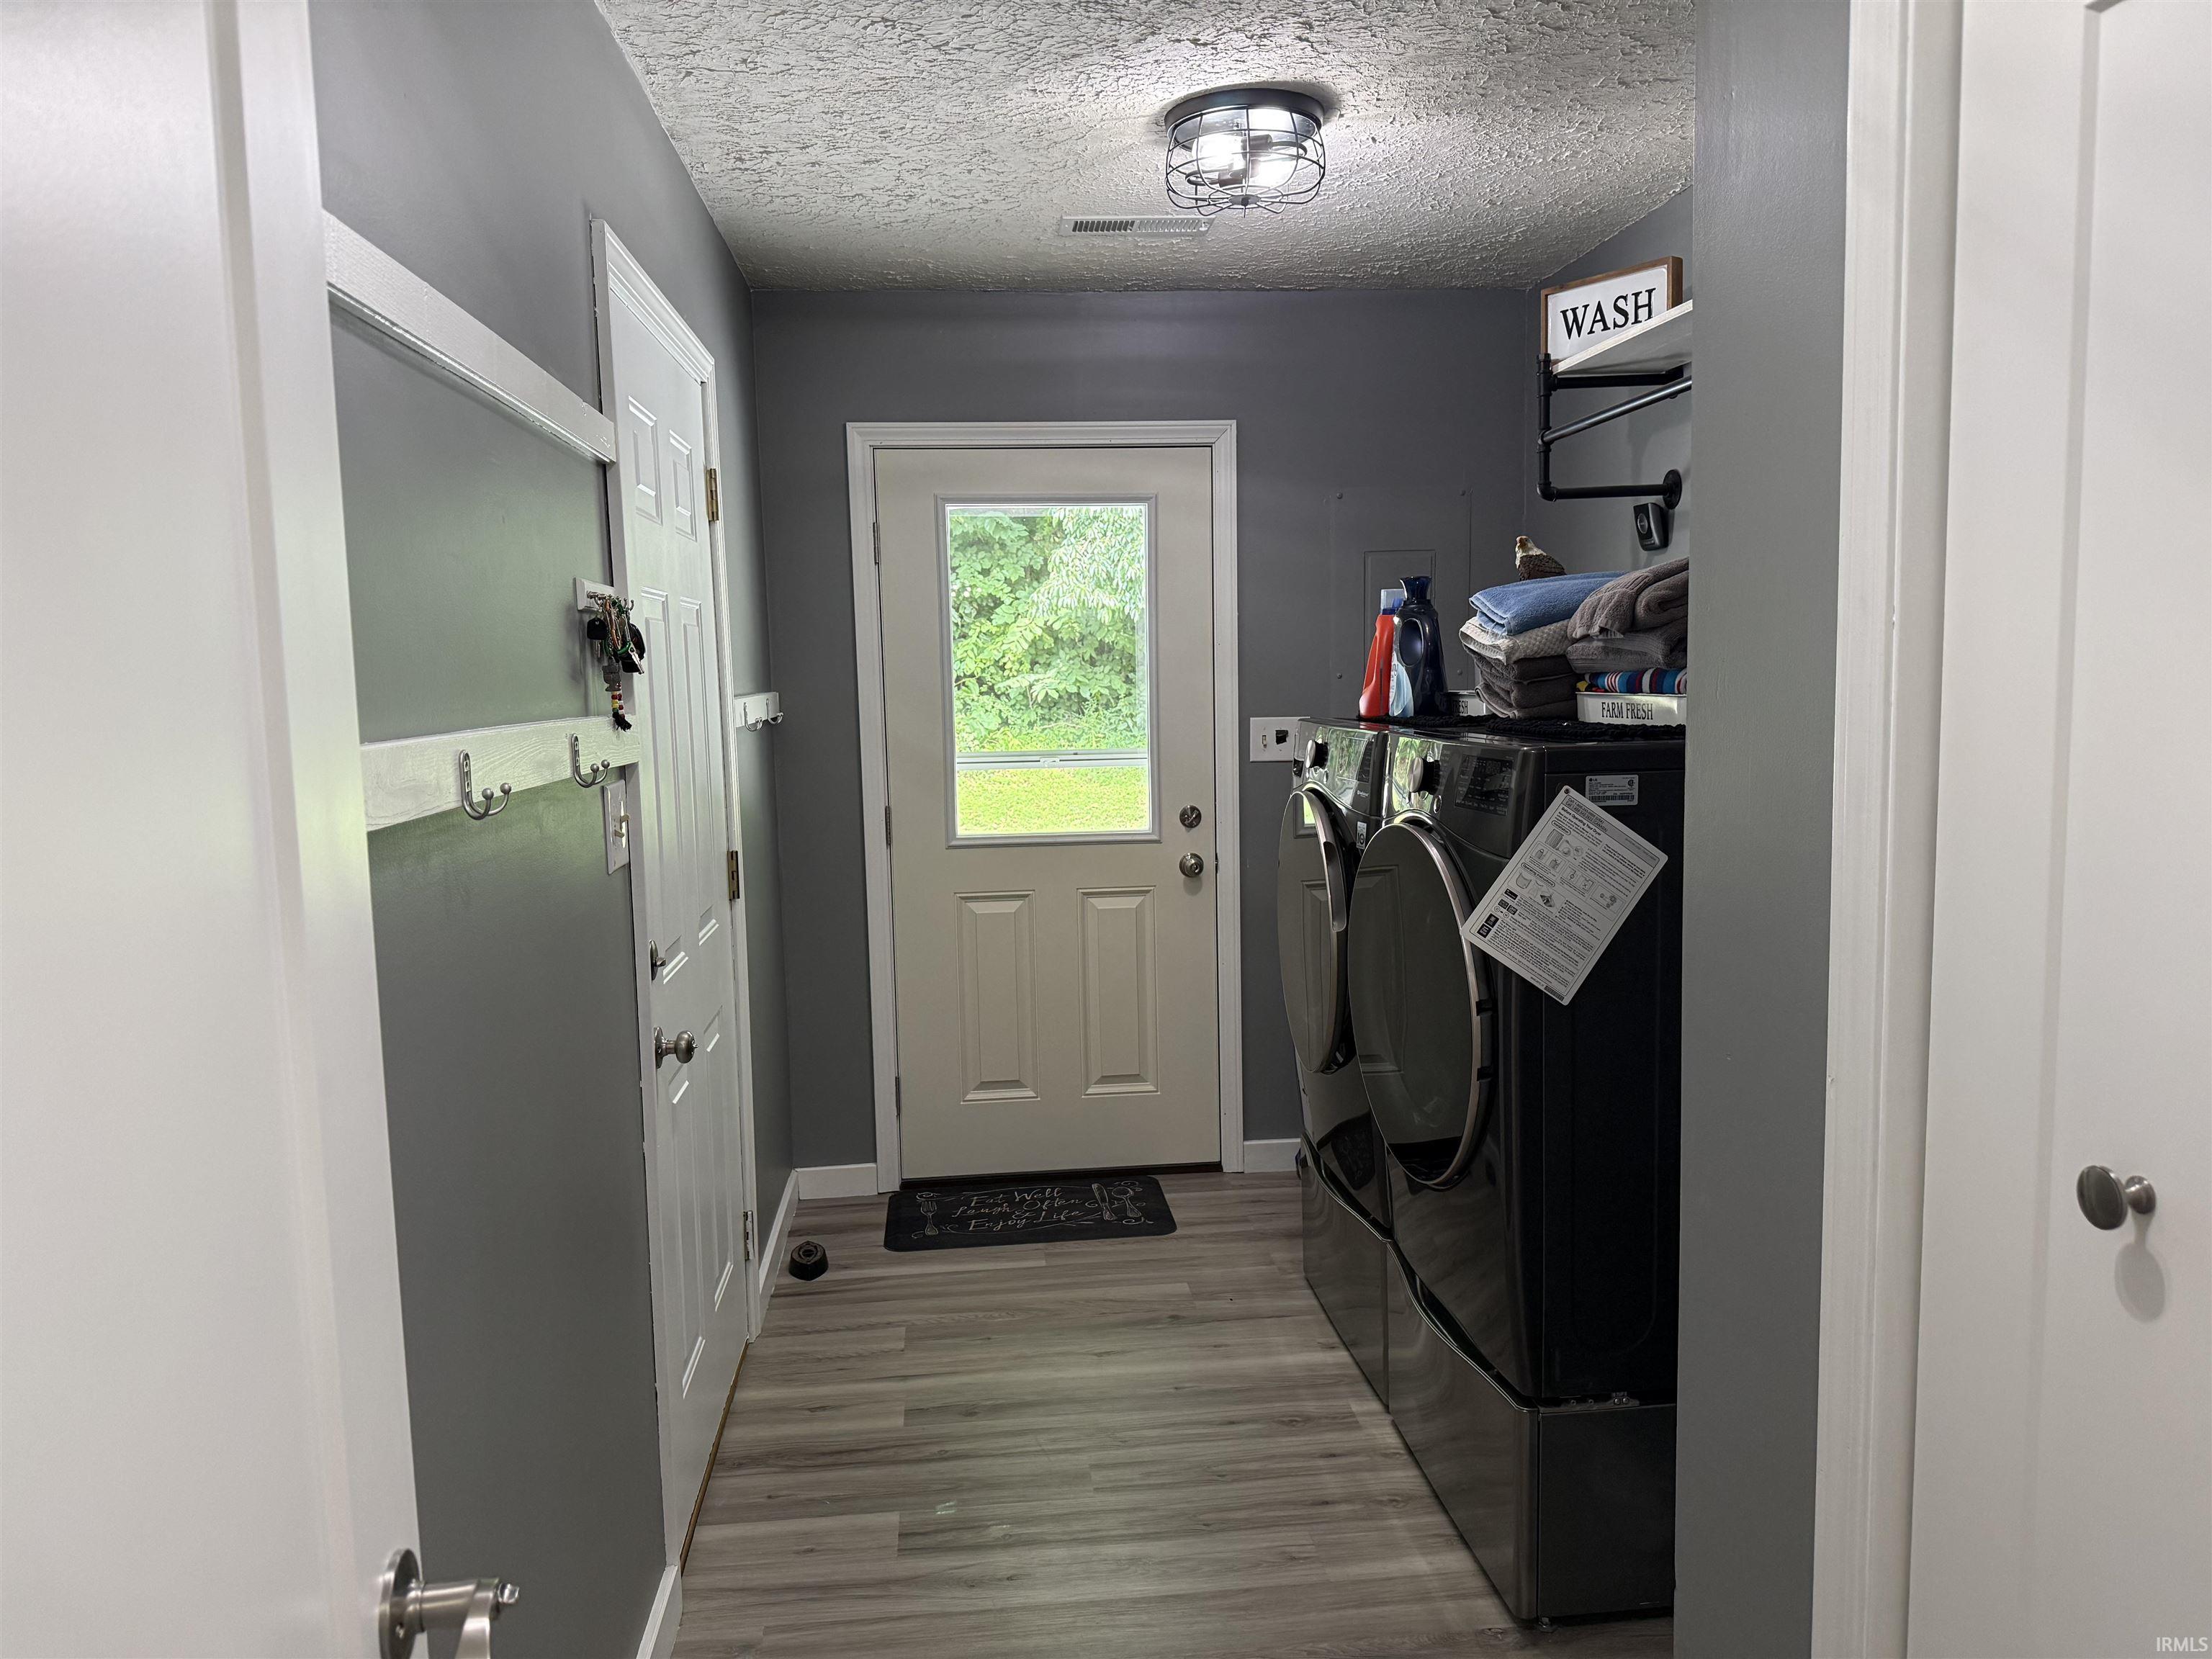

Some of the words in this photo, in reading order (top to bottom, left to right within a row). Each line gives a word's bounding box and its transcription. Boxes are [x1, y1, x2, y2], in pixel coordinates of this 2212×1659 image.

[1560, 287, 1656, 340] WASH
[1601, 701, 1624, 719] FARM
[1625, 702, 1653, 720] FRESH
[971, 1194, 1007, 1207] Eat
[1015, 1187, 1062, 1202] Well
[951, 1203, 1015, 1217] Laugh
[1022, 1198, 1083, 1210] Often
[967, 1218, 1032, 1231] Enjoy
[1033, 1210, 1085, 1223] Life
